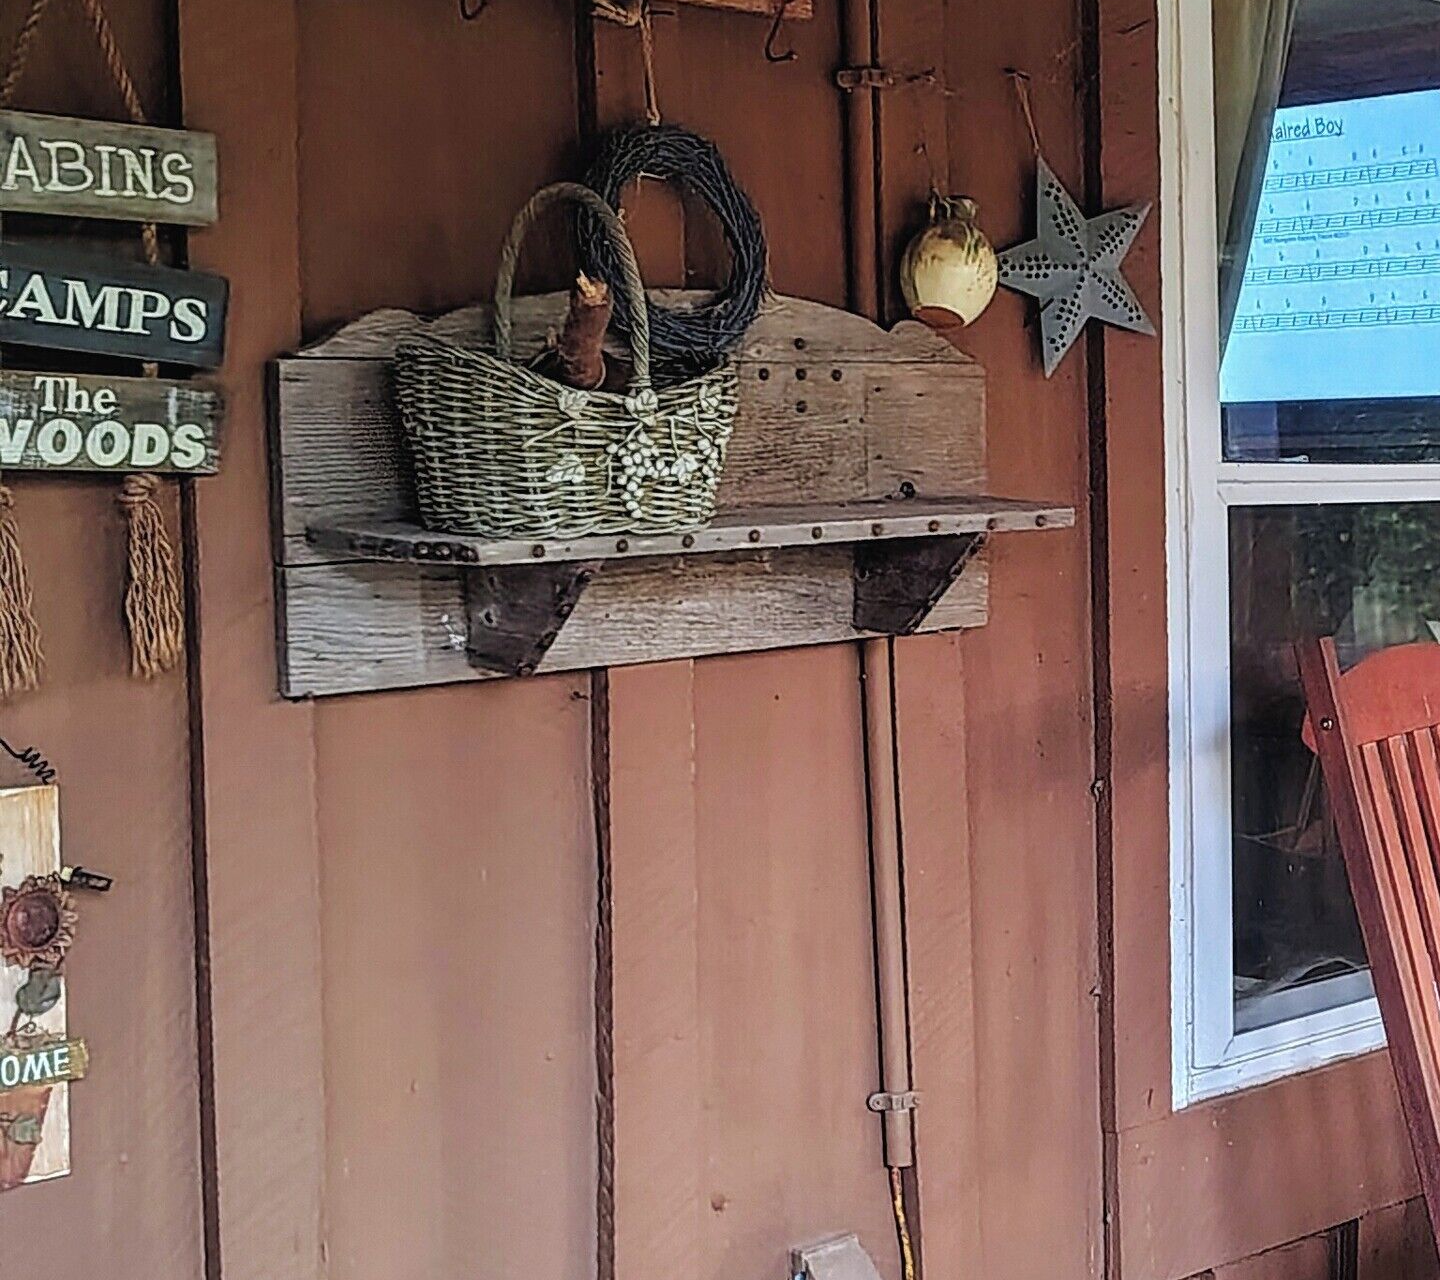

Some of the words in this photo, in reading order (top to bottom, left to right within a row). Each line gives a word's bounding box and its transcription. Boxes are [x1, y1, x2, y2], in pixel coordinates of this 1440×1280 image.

[1315, 117, 1344, 137] Boy
[1, 136, 195, 204] ABINS
[0, 269, 208, 342] AMPS
[34, 376, 116, 414] The
[1, 1047, 71, 1086] OME
